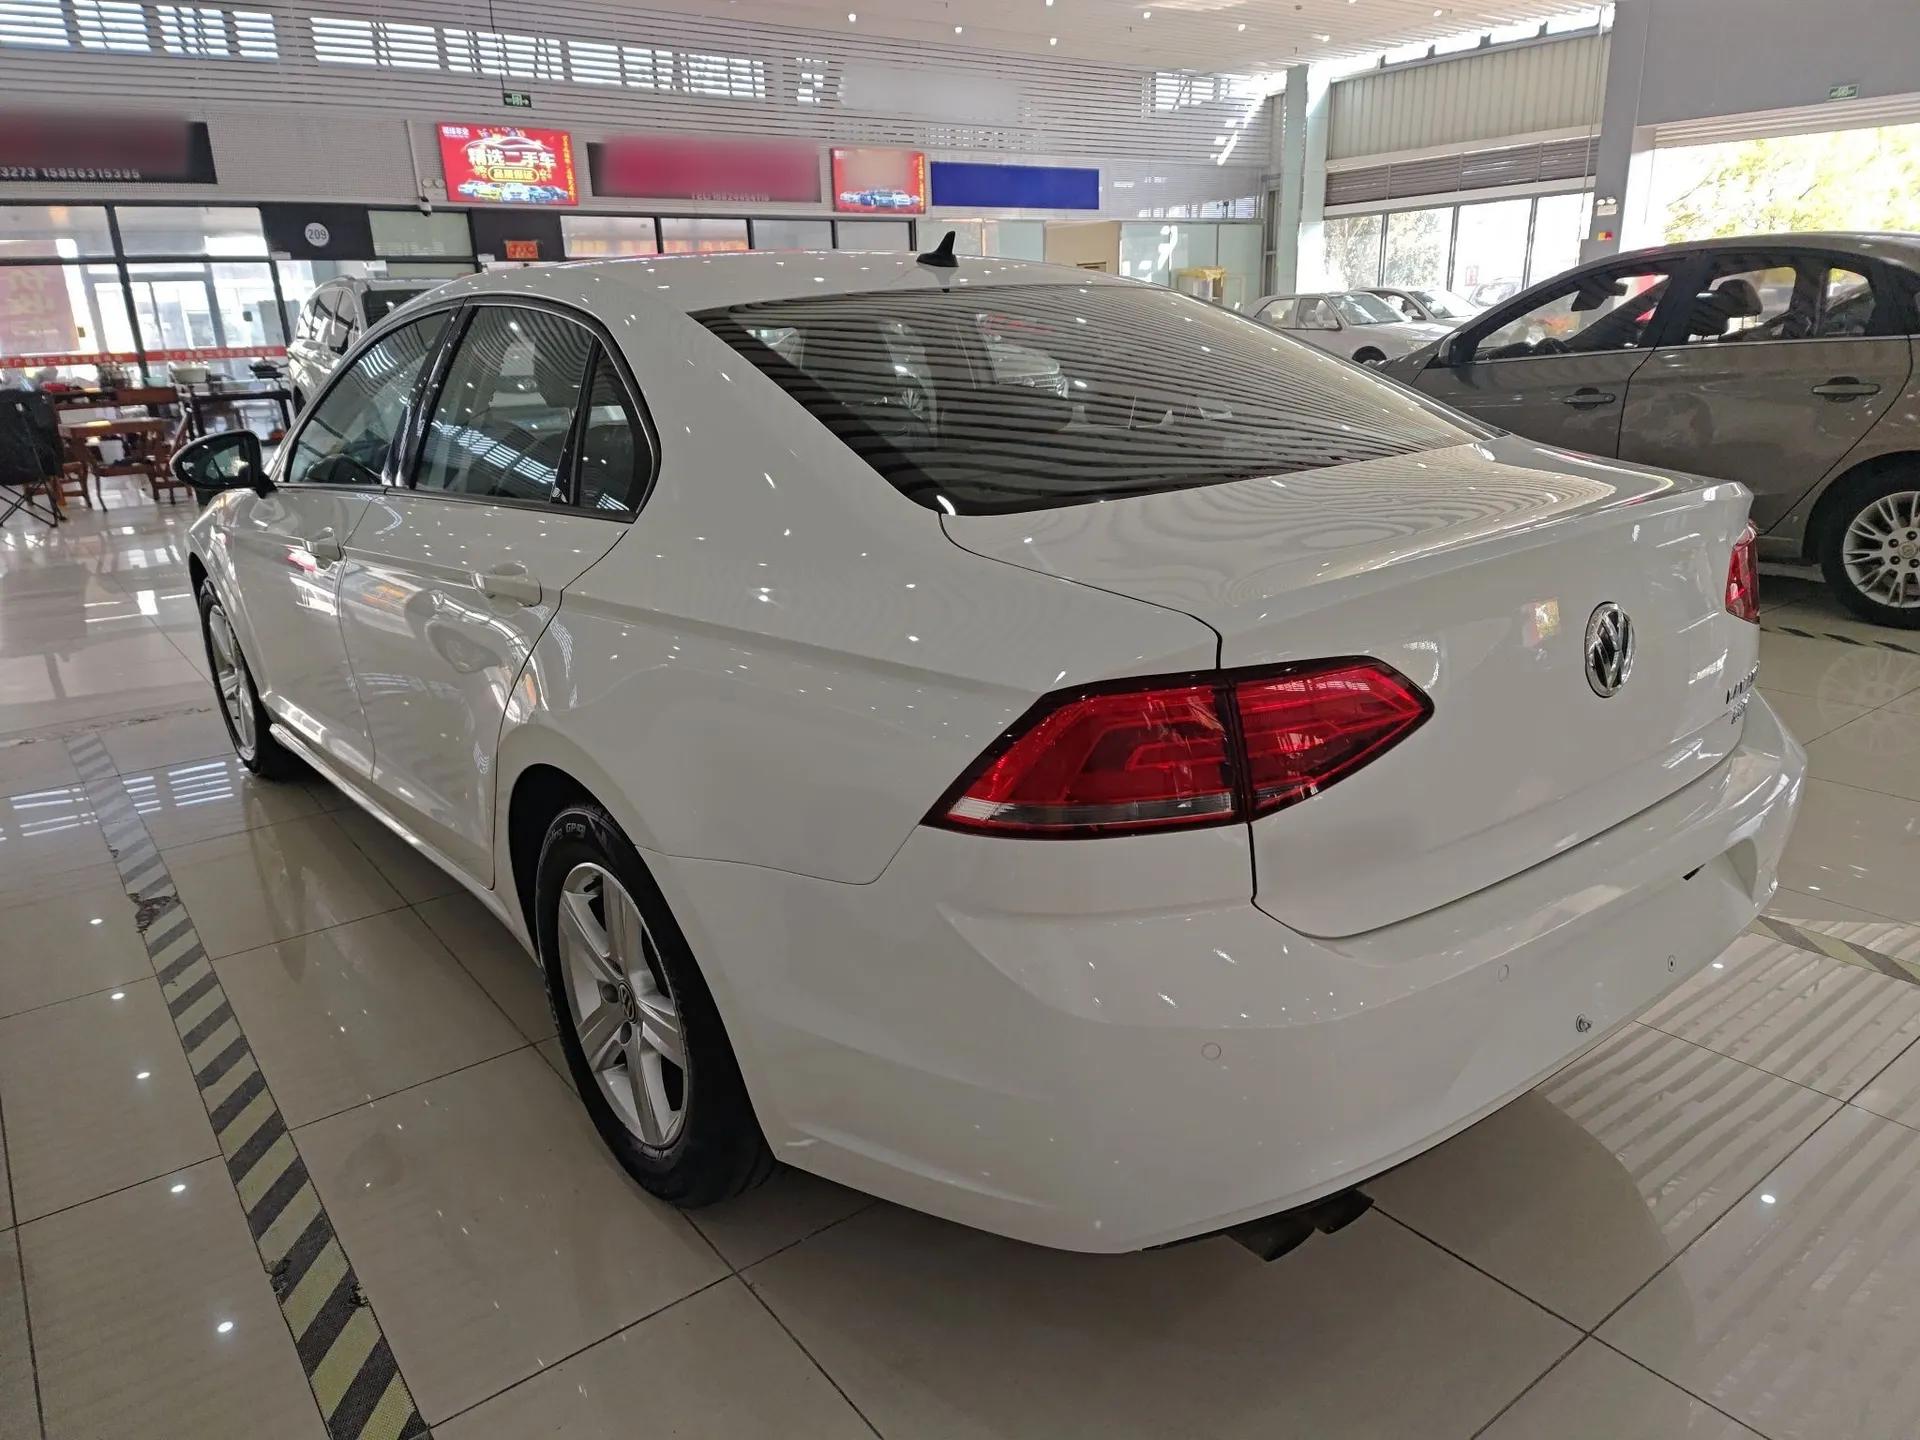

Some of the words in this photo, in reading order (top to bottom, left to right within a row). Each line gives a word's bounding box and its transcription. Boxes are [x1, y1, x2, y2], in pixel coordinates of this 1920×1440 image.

[467, 148, 557, 168] 精选二手车
[307, 228, 327, 240] 209
